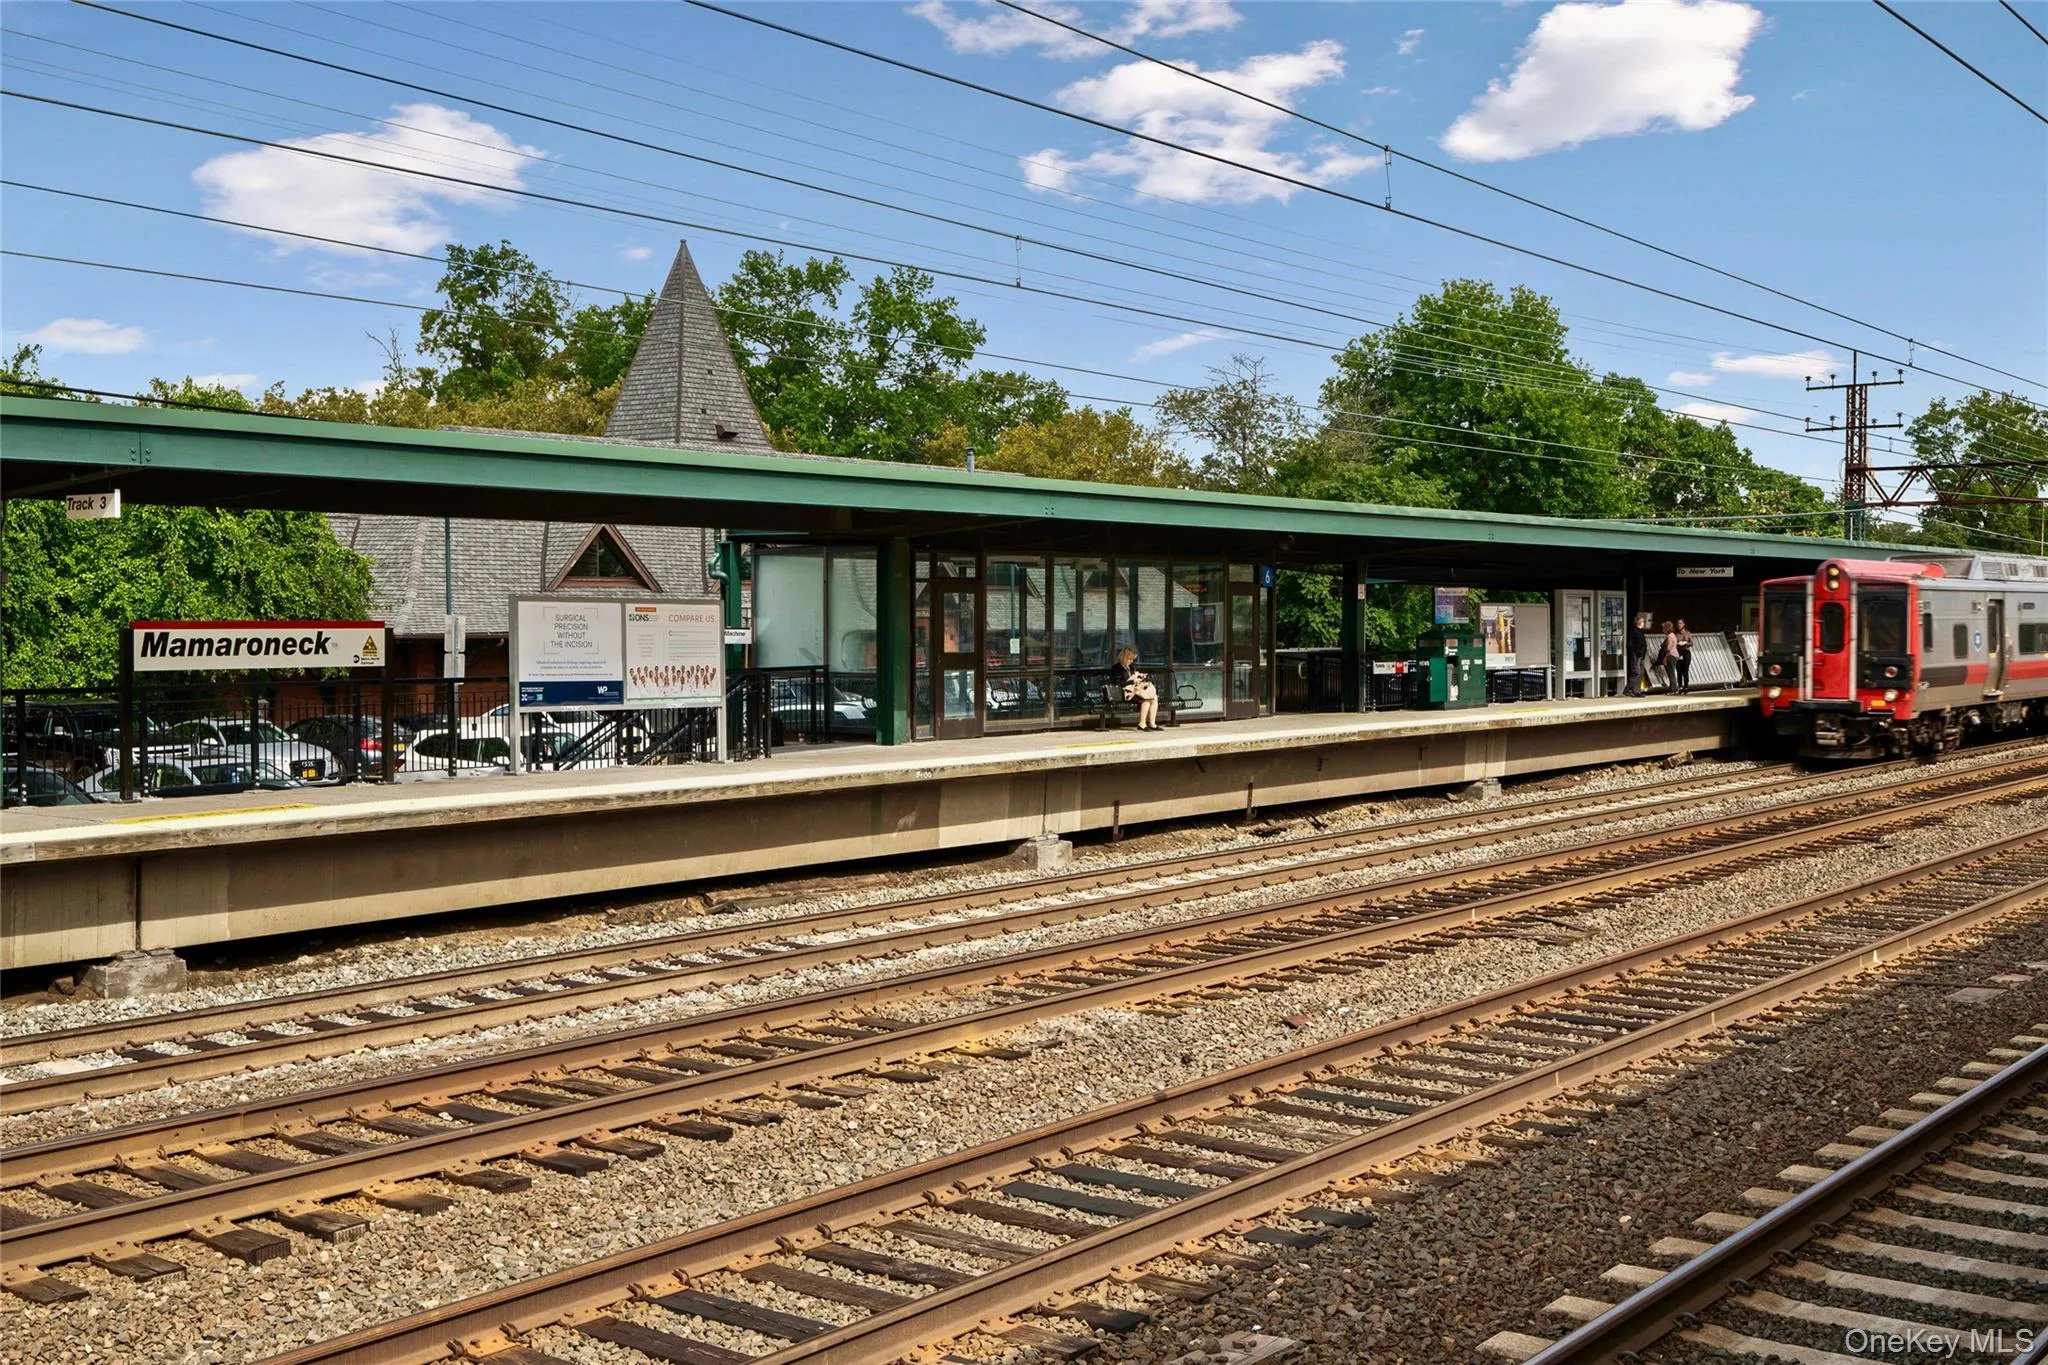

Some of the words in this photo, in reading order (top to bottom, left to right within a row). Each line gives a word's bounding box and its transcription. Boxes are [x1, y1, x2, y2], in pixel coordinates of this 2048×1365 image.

[67, 496, 94, 511] Track
[99, 496, 107, 509] 3
[1265, 570, 1271, 584] 6
[555, 614, 588, 622] SURGICAL
[668, 614, 703, 623] COMPARE
[140, 631, 332, 658] Mamaroneck
